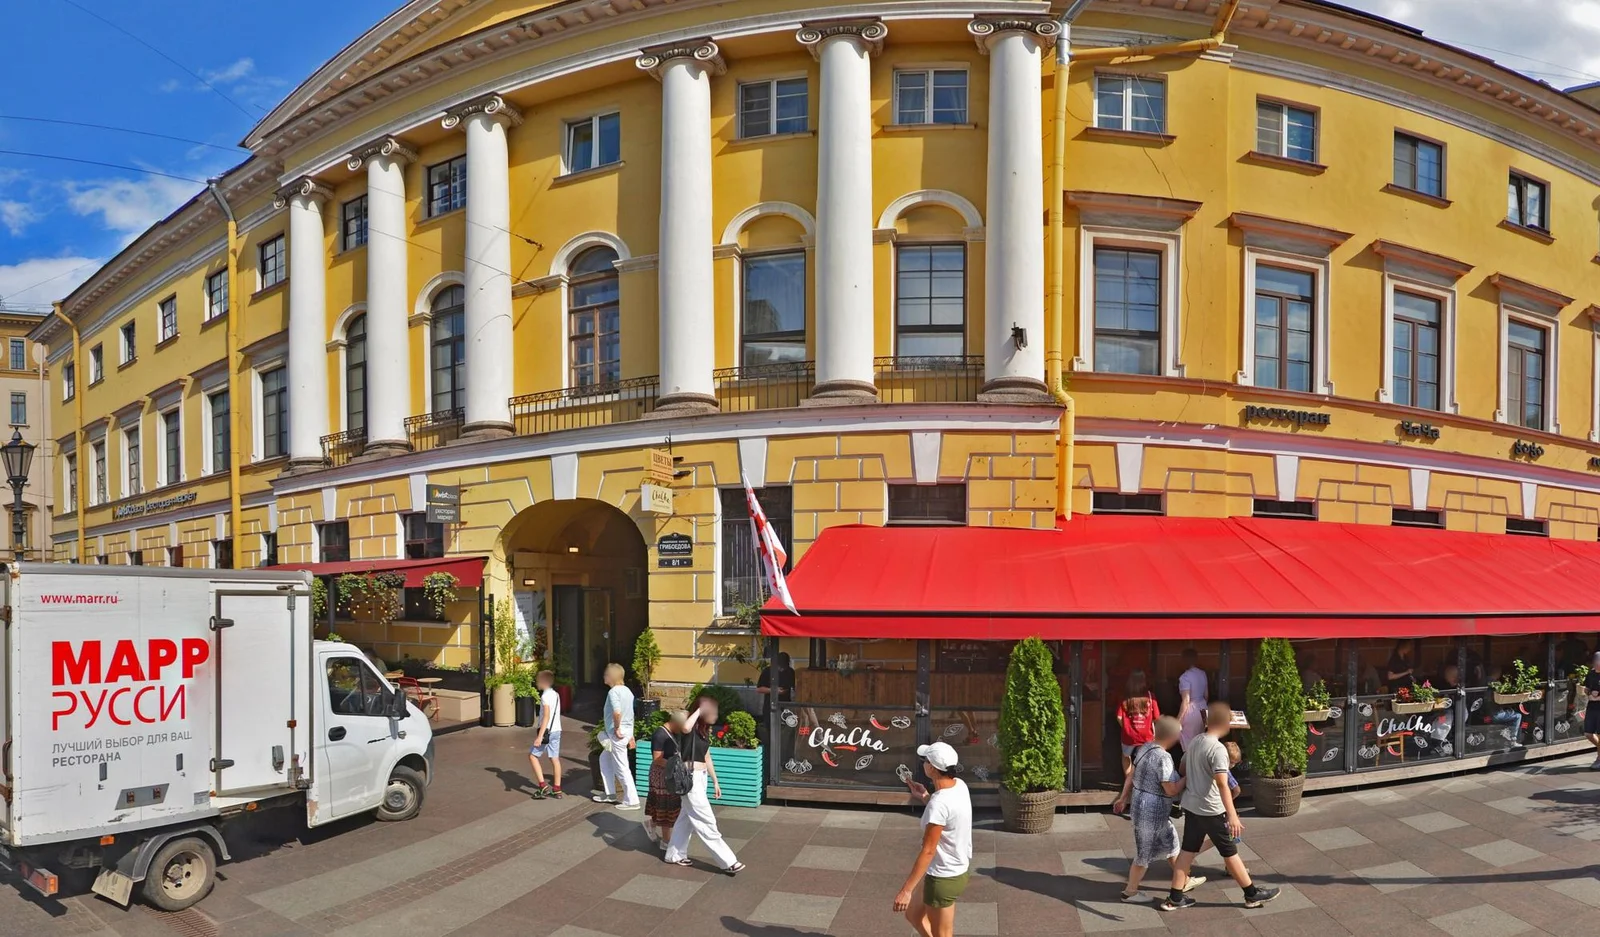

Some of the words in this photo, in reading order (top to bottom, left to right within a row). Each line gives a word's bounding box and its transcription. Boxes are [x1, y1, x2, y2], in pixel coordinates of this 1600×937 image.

[1245, 405, 1331, 426] ресторан
[653, 453, 672, 466] ЦВЕТЫ
[659, 543, 691, 551] ГРИБОЕДОВА
[41, 593, 118, 605] www.marr.ru
[51, 638, 210, 686] МАРР
[51, 684, 187, 731] РУССИ
[1376, 714, 1436, 737] ChaCha
[52, 737, 103, 754] ЛУЧШИЙ
[106, 735, 144, 749] ВЫБОР
[146, 733, 168, 746] ДЛЯ
[808, 726, 889, 752] ChaCha
[52, 753, 122, 768] РЕСТОРАНА
